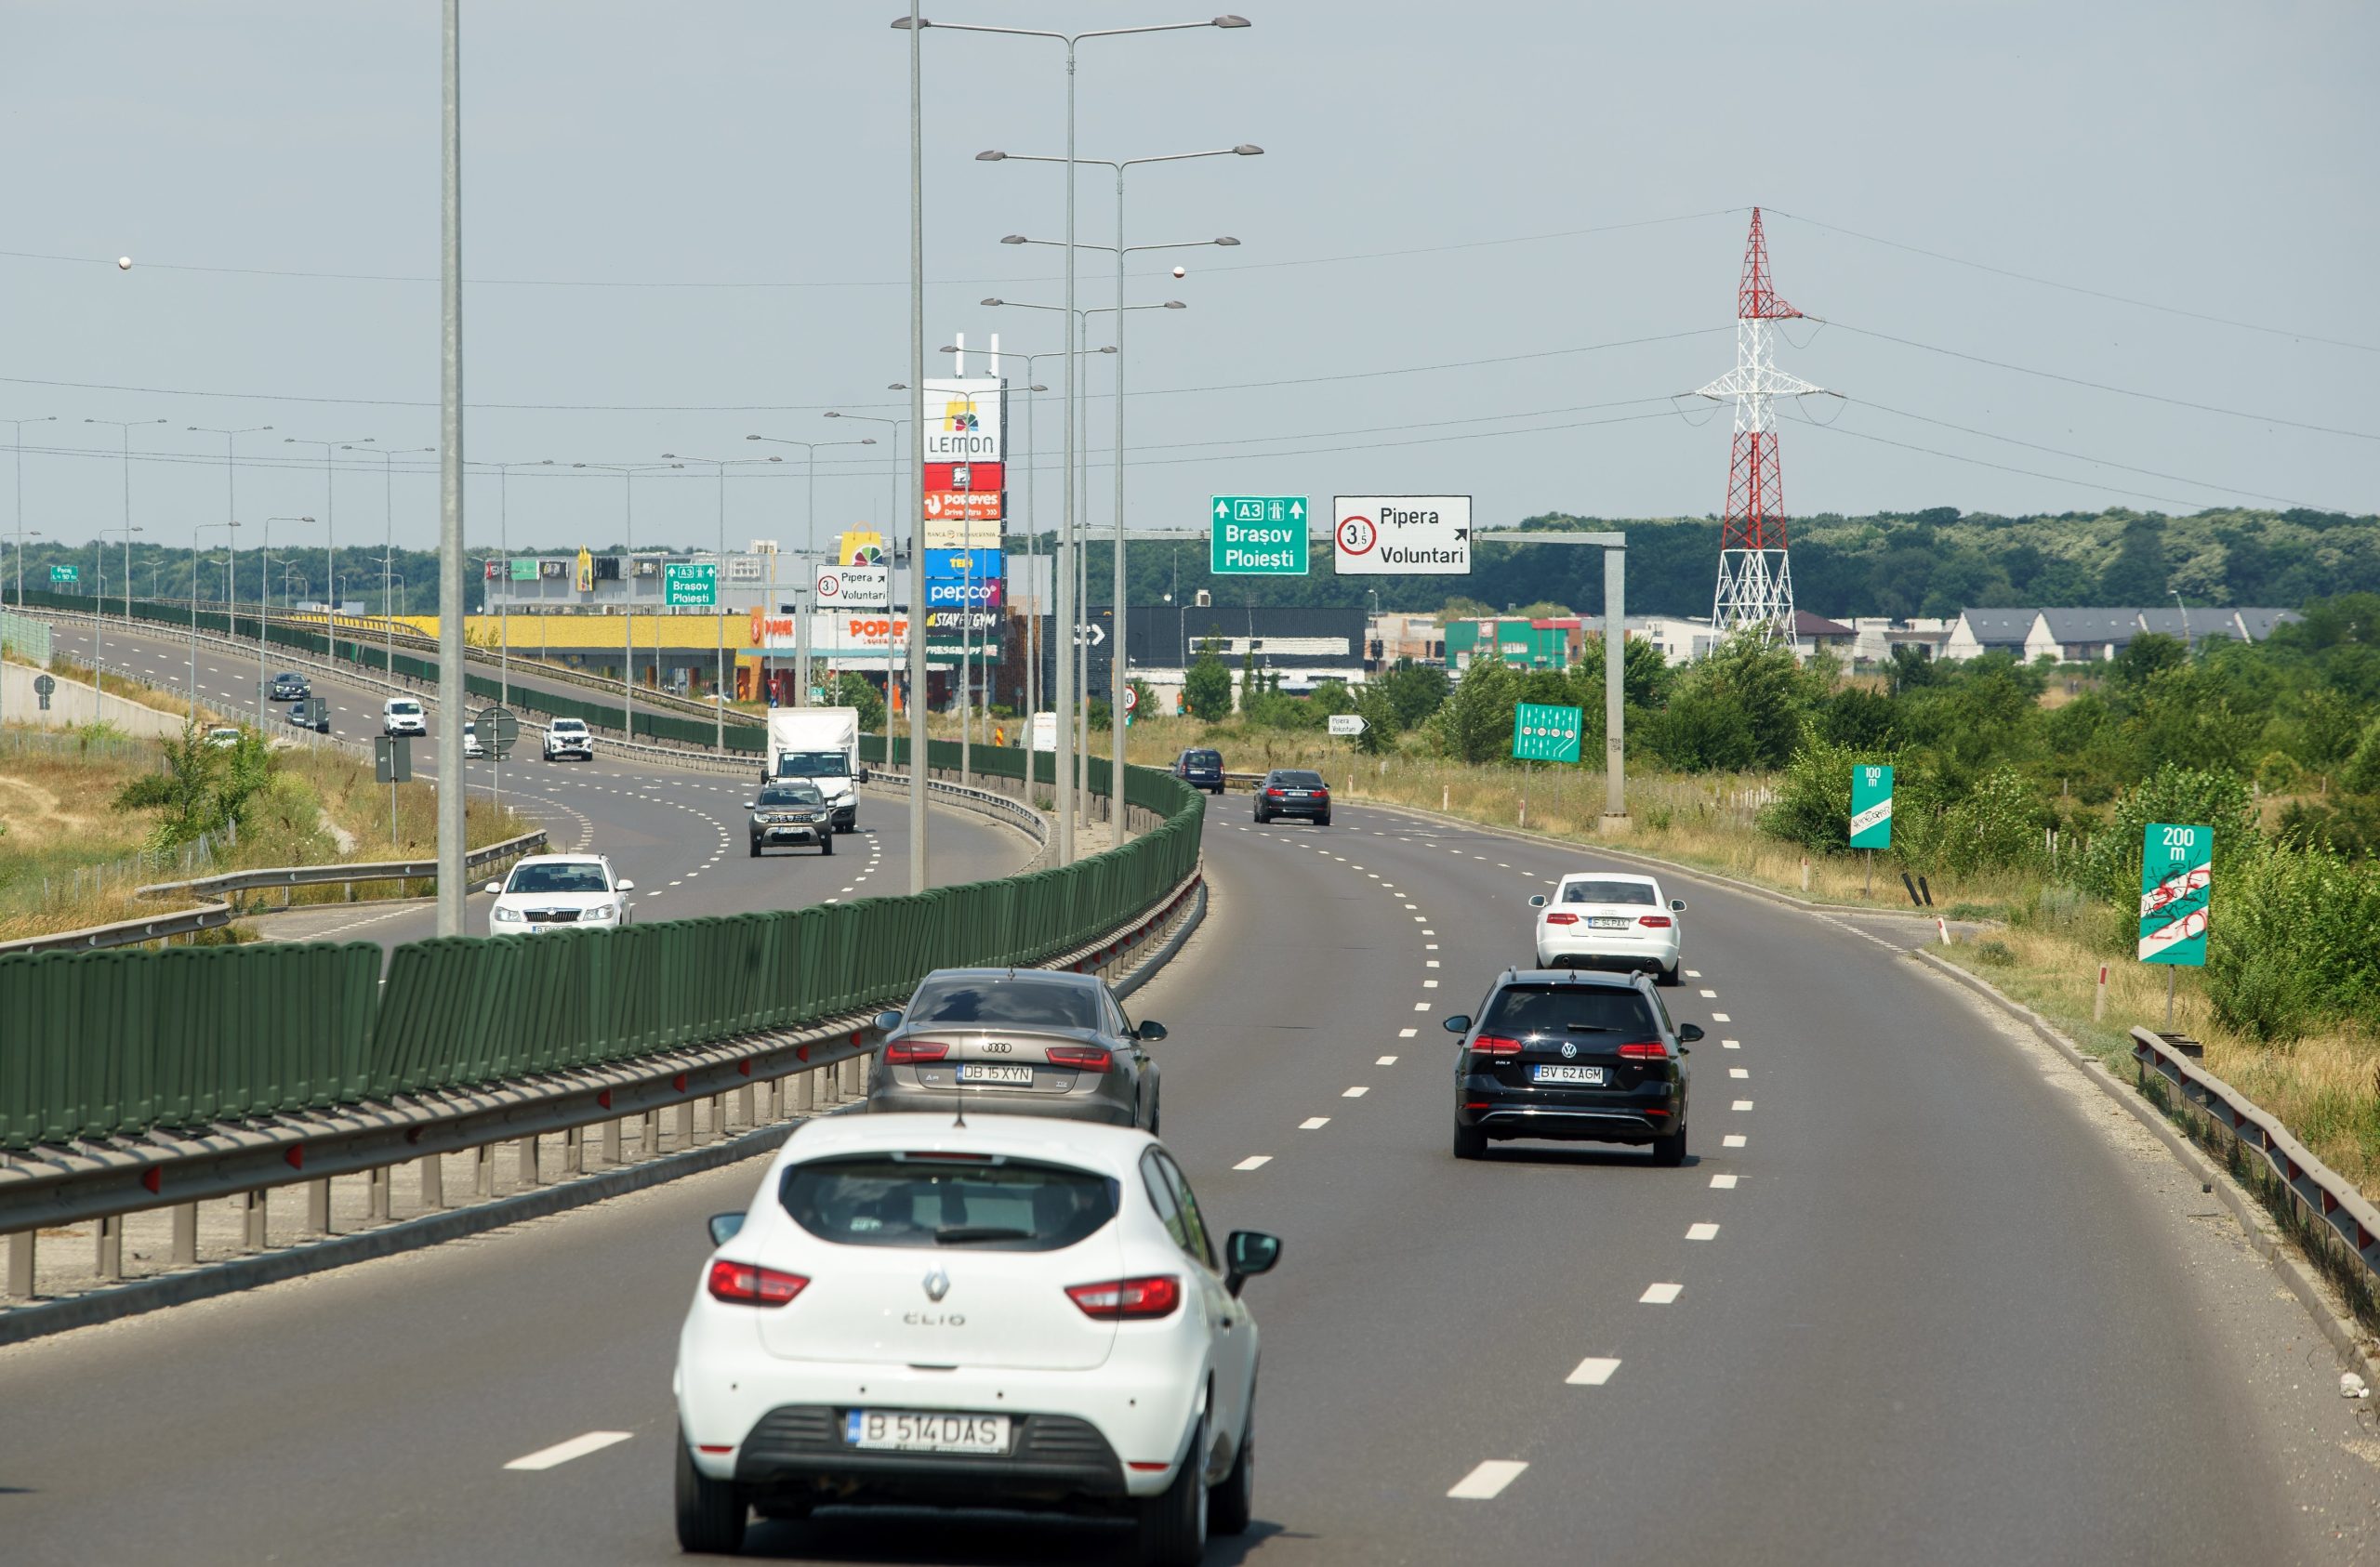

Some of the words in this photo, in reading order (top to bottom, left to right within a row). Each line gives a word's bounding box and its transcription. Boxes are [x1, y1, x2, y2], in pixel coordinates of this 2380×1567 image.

[930, 437, 994, 454] LEMON
[1239, 504, 1261, 518] A3
[1381, 507, 1439, 528] Pipera
[1225, 524, 1293, 546] Brașov
[1225, 548, 1294, 570] Ploiești
[1380, 546, 1464, 563] Voluntari
[681, 568, 693, 576] A3
[841, 573, 872, 584] Pipera
[841, 590, 885, 599] Voluntari
[931, 586, 991, 602] pepco
[1865, 767, 1881, 779] 100
[1868, 779, 1877, 787] m
[2162, 827, 2195, 847] 200
[2170, 848, 2185, 861] m
[964, 1065, 983, 1078] DB
[988, 1067, 999, 1079] 15
[1001, 1068, 1029, 1080] XYN
[1541, 1066, 1557, 1078] BV
[1562, 1067, 1576, 1079] 62
[1578, 1068, 1601, 1080] AGM
[903, 1313, 967, 1326] CLIO
[867, 1415, 885, 1441] B
[897, 1416, 936, 1442] 514
[943, 1416, 998, 1444] DAS
